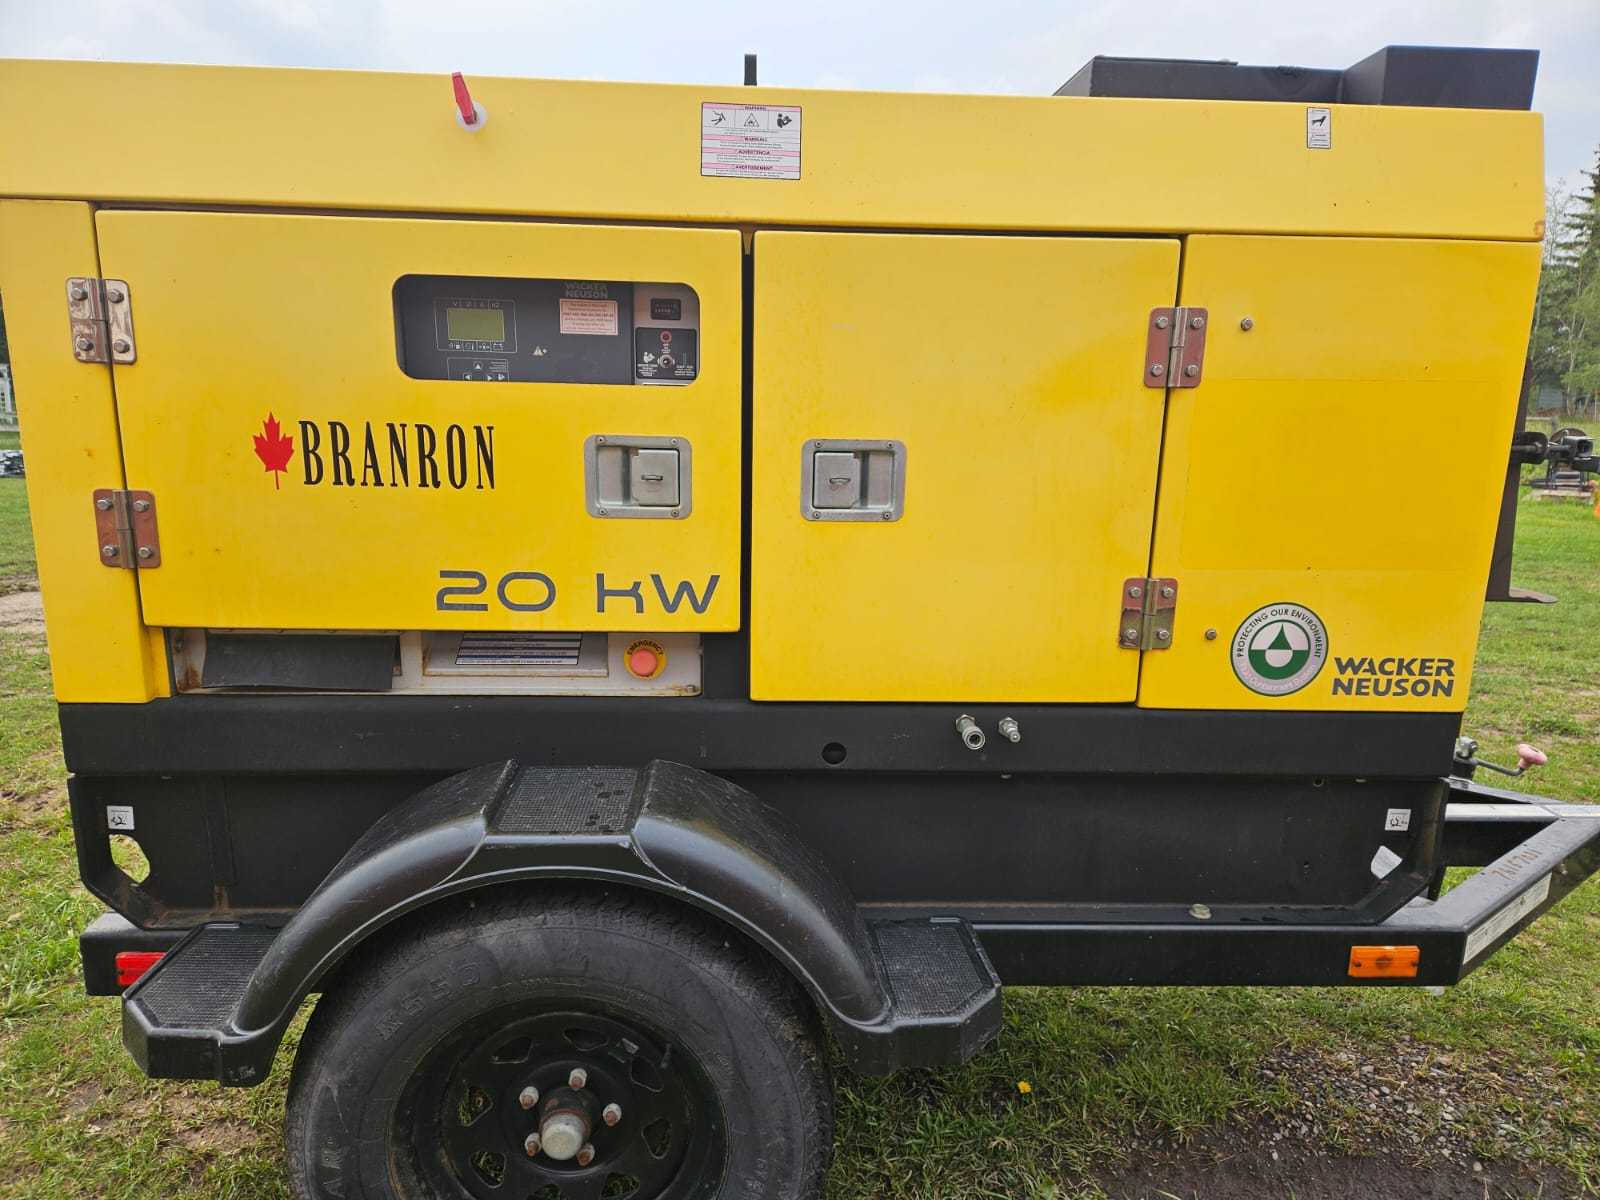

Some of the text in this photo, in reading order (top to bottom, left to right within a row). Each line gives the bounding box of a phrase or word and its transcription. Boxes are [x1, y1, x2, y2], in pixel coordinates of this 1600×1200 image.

[565, 290, 608, 299] NEUSON
[299, 421, 495, 489] BRANRON
[436, 570, 556, 612] 20
[1236, 608, 1323, 659] PROTECTING OUR ENVIRONMENT
[626, 639, 664, 656] EMERGENCY
[1334, 657, 1455, 676] WACKER
[1332, 678, 1454, 697] NEUSON
